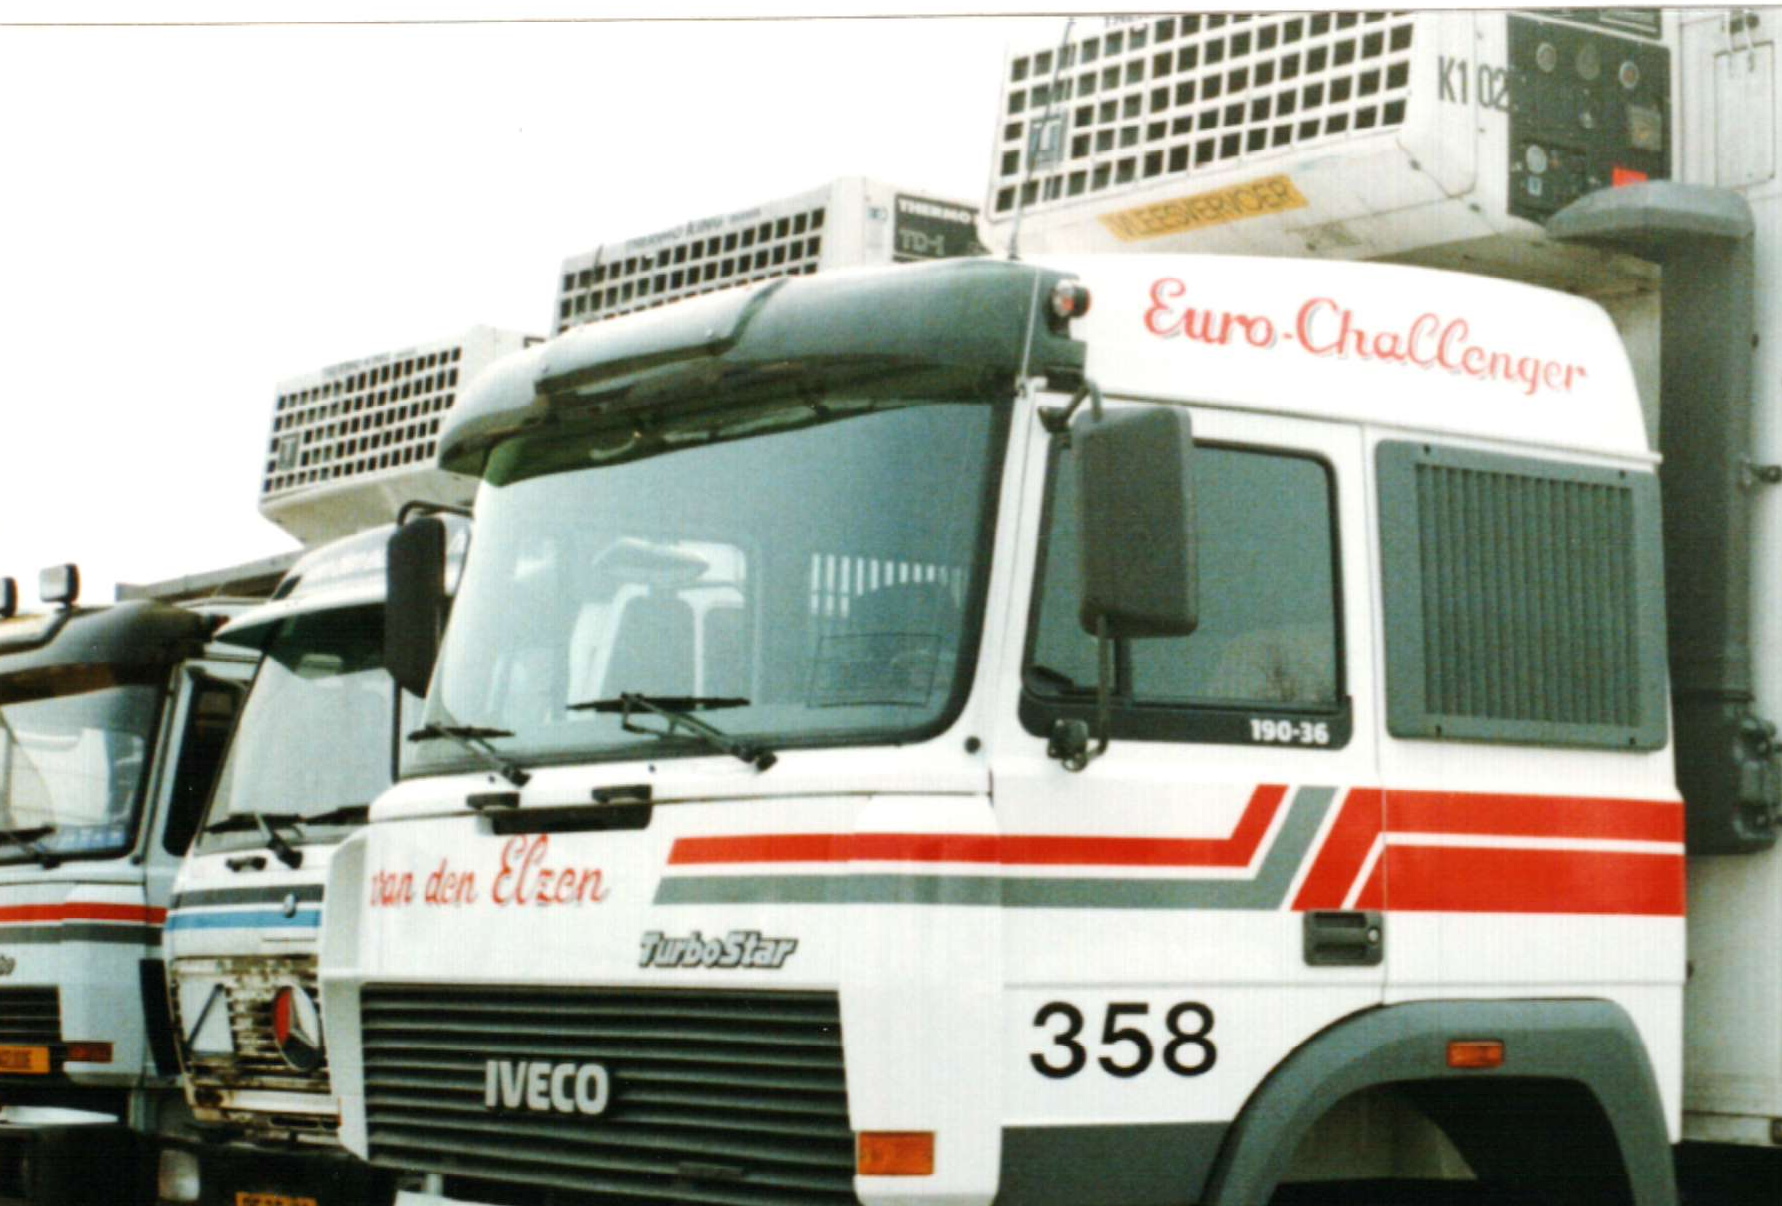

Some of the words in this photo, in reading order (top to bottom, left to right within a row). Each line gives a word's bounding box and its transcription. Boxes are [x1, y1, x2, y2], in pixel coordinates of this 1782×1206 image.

[1249, 718, 1331, 745] 190-36
[370, 868, 415, 907] van
[424, 858, 478, 907] den
[491, 832, 611, 908] Elzen
[637, 930, 799, 970] TurboStar
[1028, 1000, 1220, 1081] 358
[484, 1059, 610, 1116] IVECO
